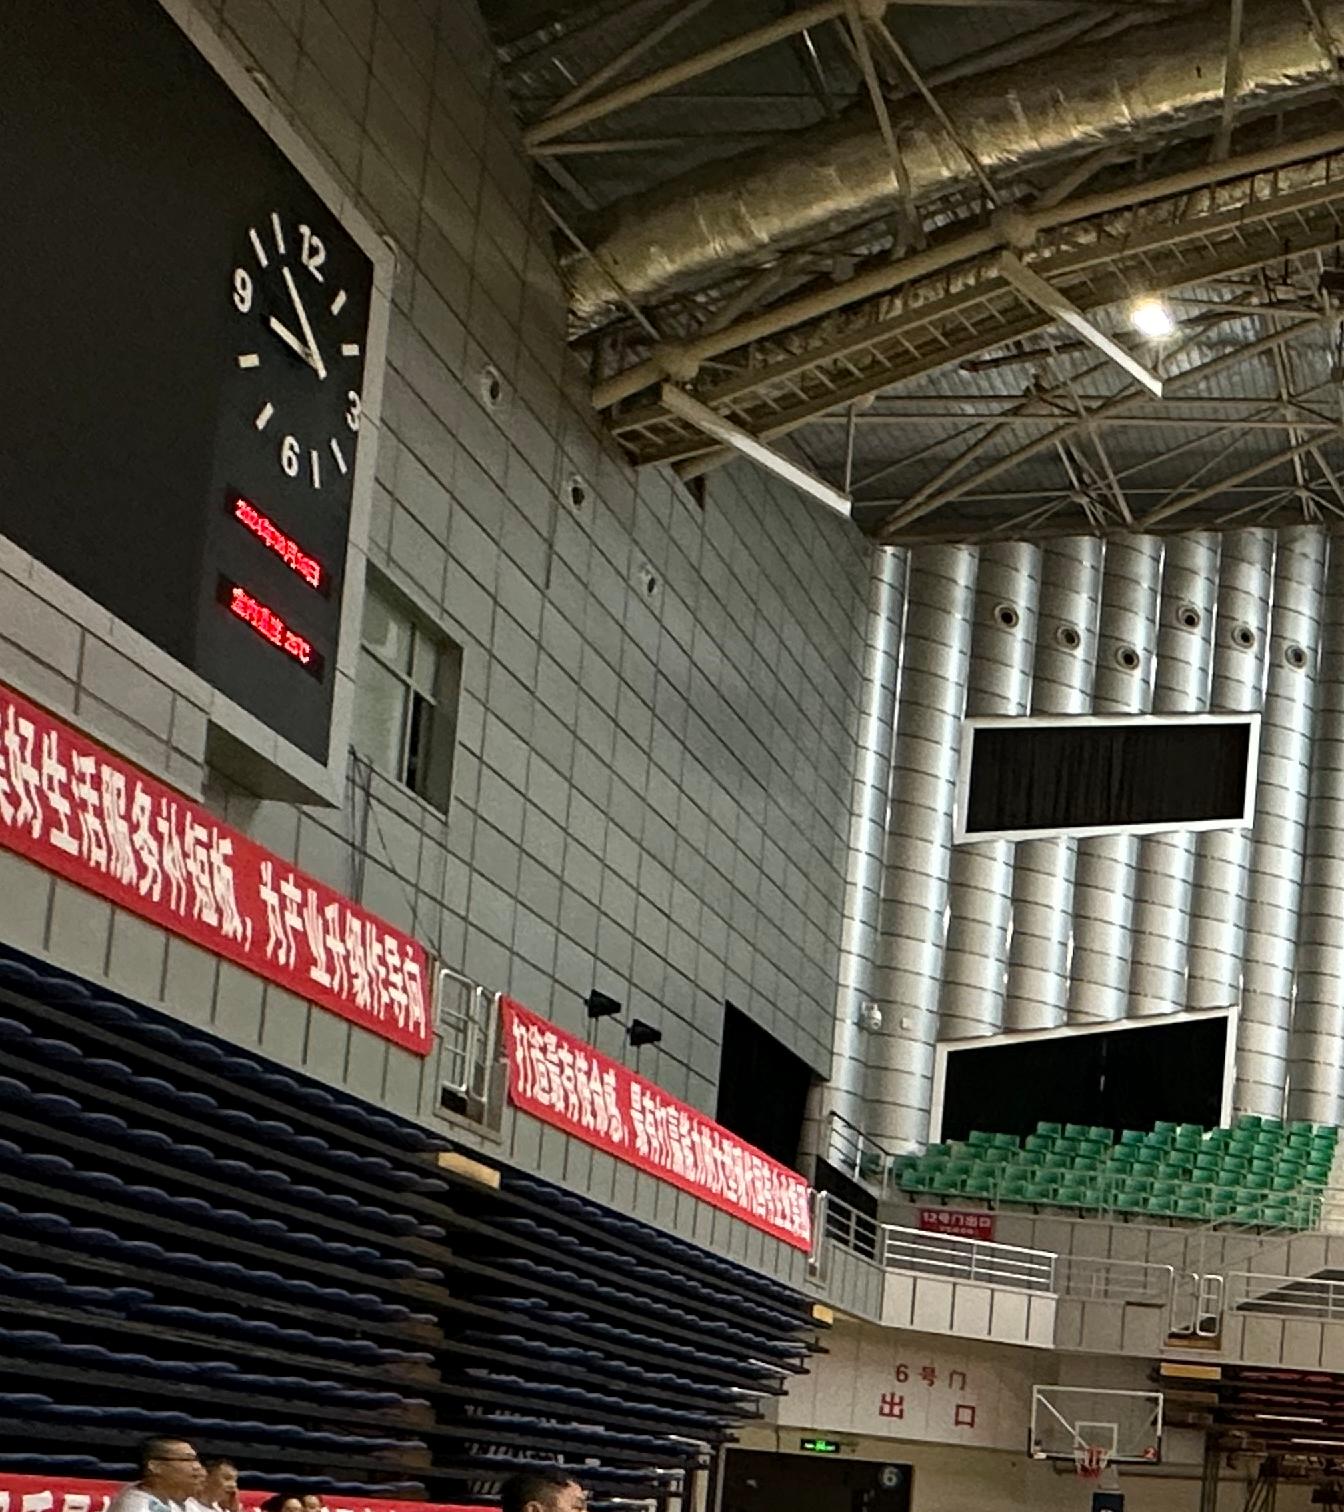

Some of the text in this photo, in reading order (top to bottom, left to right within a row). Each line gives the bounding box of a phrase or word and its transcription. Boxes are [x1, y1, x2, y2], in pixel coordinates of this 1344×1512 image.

[299, 224, 326, 283] 12
[233, 268, 253, 314] 9
[346, 391, 362, 432] 3
[281, 435, 300, 478] 6
[896, 1364, 967, 1391] 6号门
[879, 1392, 976, 1428] 出口
[883, 1466, 898, 1487] 6
